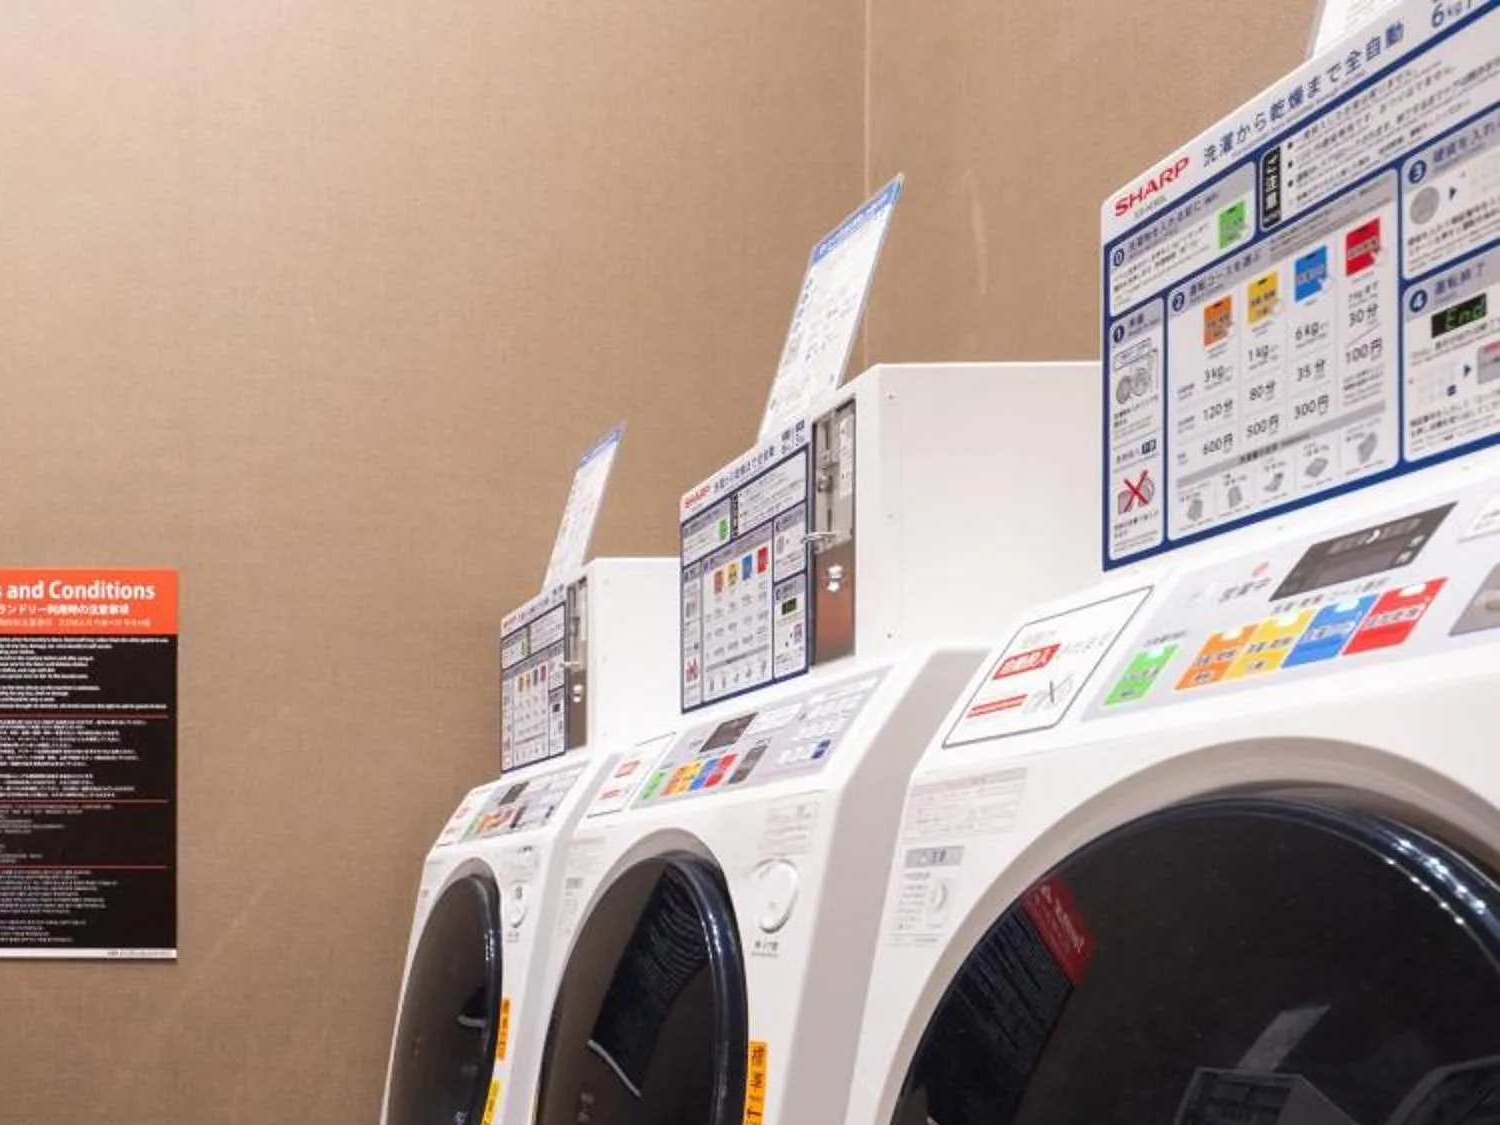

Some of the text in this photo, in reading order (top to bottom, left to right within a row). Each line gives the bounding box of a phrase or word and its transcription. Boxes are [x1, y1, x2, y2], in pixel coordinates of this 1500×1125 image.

[1114, 156, 1190, 218] SHARP
[1444, 297, 1485, 331] End
[7, 580, 44, 600] and
[49, 579, 156, 600] Conditions
